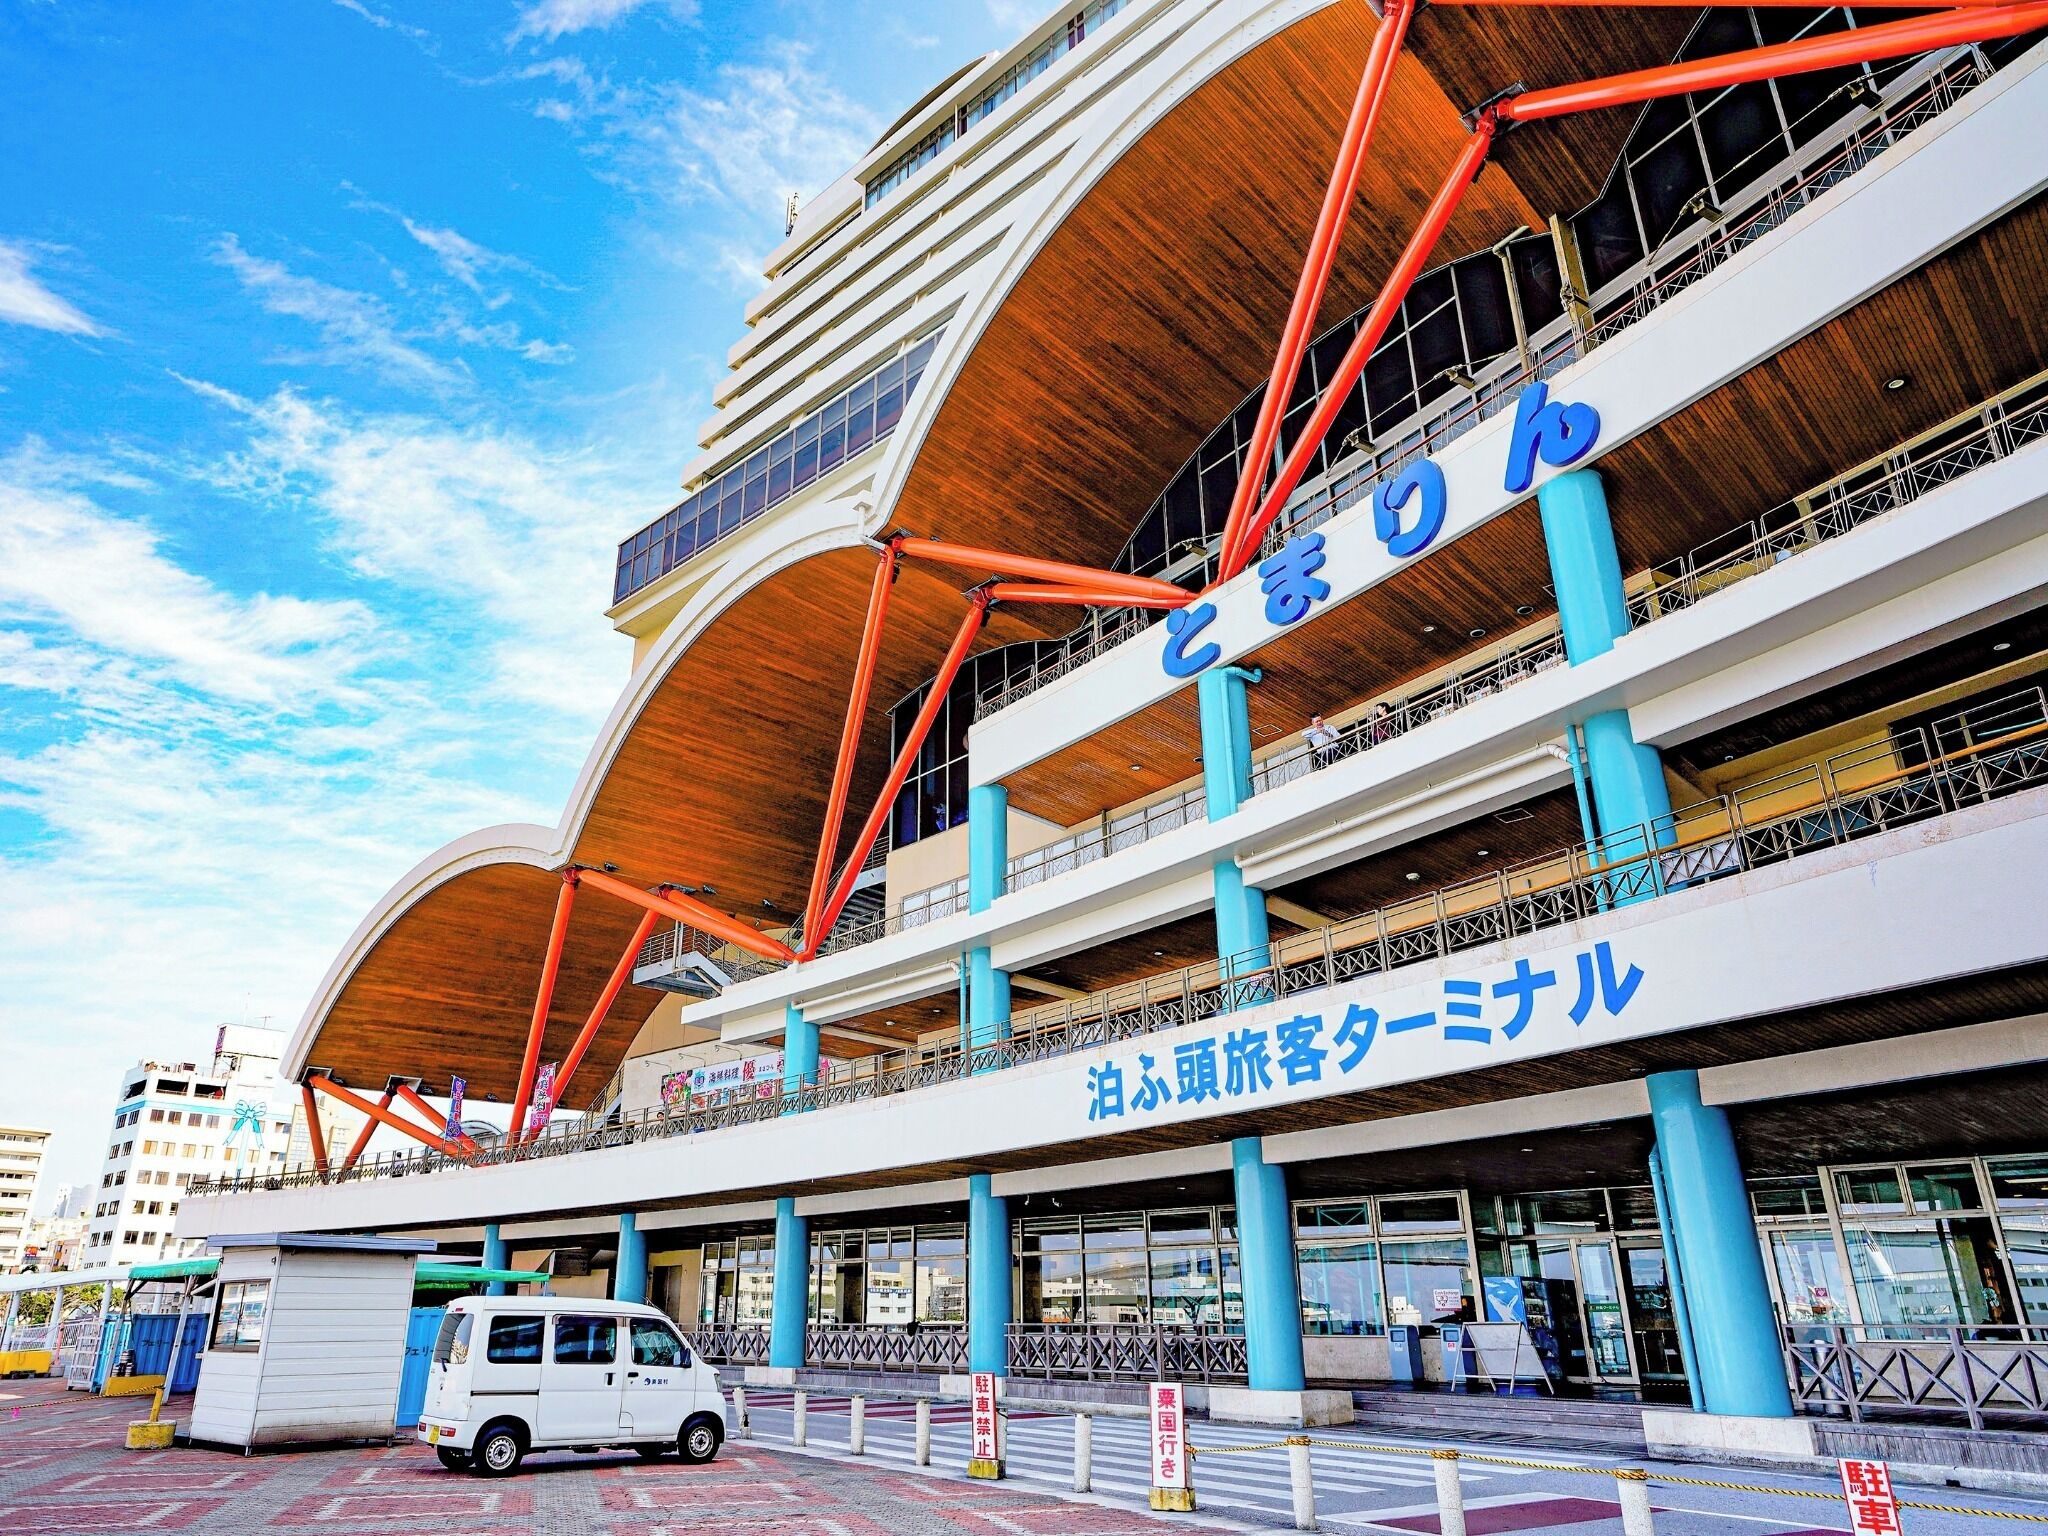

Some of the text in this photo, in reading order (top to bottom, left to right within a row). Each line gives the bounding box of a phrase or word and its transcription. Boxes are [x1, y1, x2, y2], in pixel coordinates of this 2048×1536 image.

[1162, 381, 1601, 678] とまりん
[1088, 941, 1644, 1120] 泊ふ頭旅客ターミナル
[976, 1375, 991, 1457] 駐車禁止
[1157, 1388, 1178, 1478] 粟国行き
